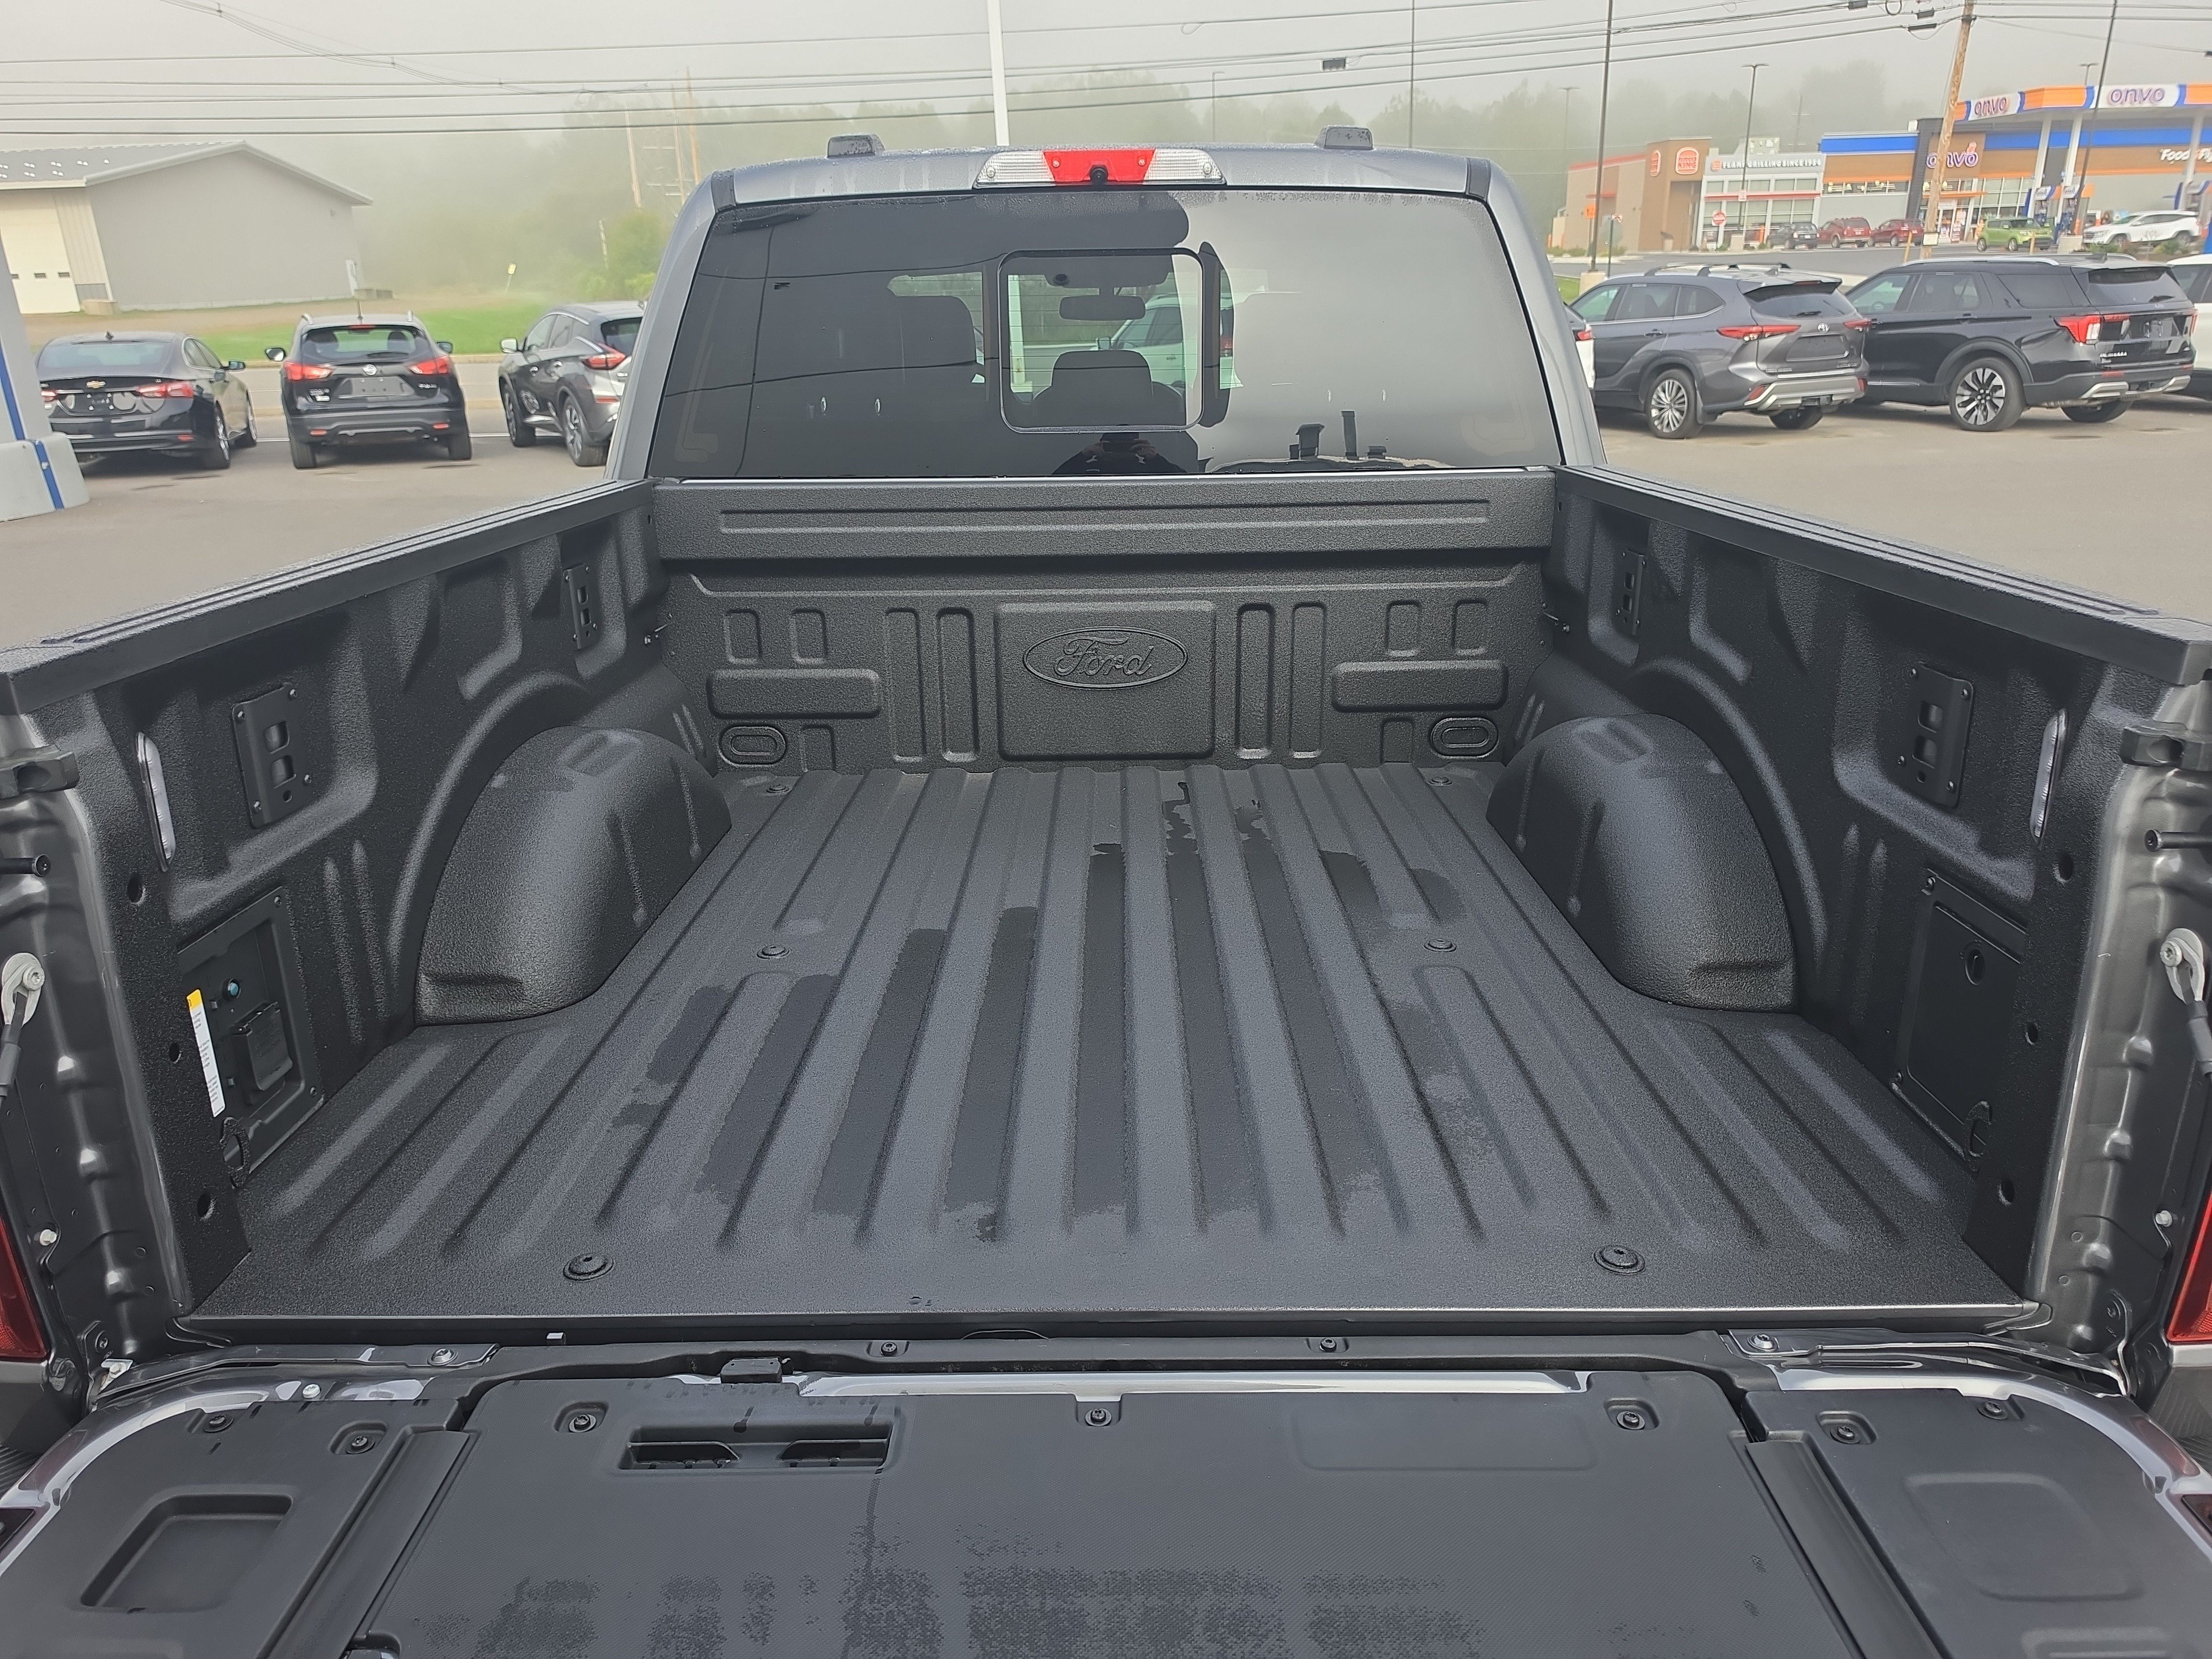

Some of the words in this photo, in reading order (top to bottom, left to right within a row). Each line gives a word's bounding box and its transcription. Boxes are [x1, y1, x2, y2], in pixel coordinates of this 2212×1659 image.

[1974, 96, 2008, 117] onvo
[2109, 87, 2165, 105] onvo
[1053, 636, 1154, 677] Ford
